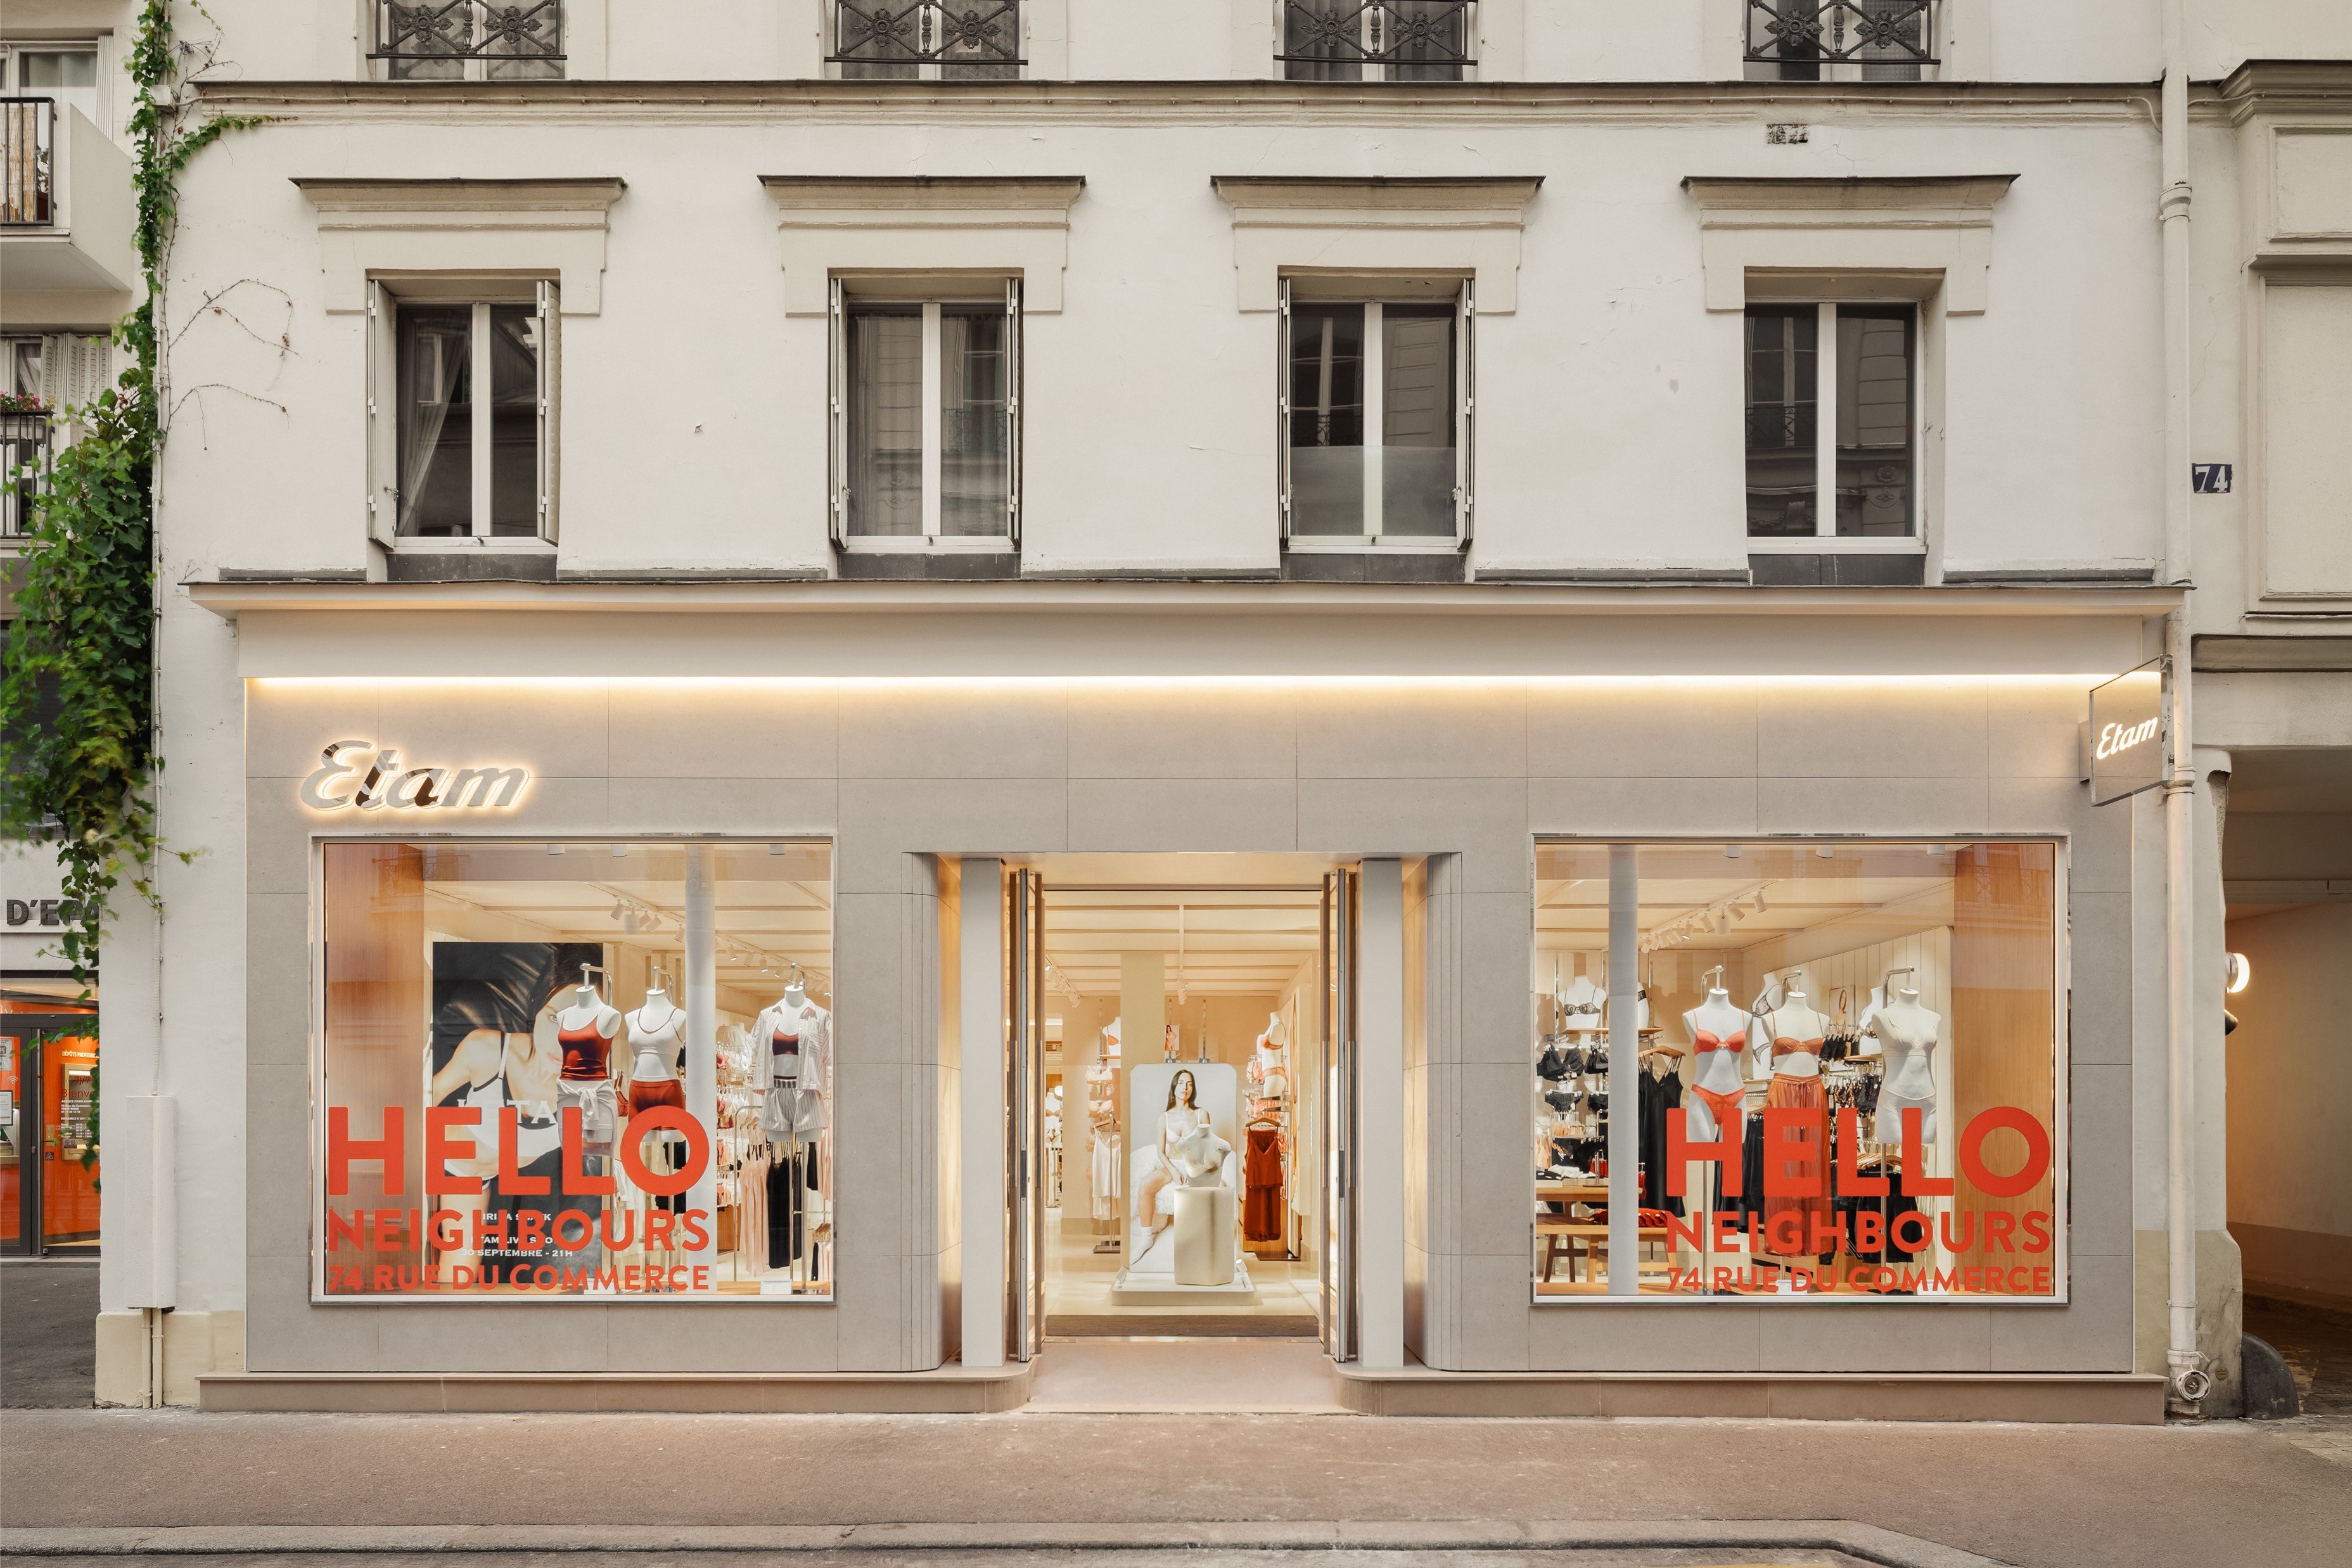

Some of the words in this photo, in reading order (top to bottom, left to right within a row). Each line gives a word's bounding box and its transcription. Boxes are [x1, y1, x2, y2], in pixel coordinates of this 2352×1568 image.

[2195, 466, 2228, 493] 74
[2095, 717, 2159, 760] Etam
[300, 740, 529, 810] Etam
[328, 1105, 710, 1197] HELLO
[1666, 1106, 2050, 1197] HELLO
[328, 1208, 710, 1252] NEIGHBOURS
[1665, 1211, 2050, 1253] NEIGHBOURS
[328, 1265, 364, 1291] 74
[374, 1265, 441, 1291] RUE
[452, 1265, 499, 1291] DU
[509, 1263, 710, 1291] COMMERCE
[1667, 1267, 1703, 1292] 74
[1713, 1266, 1779, 1292] RUE
[1790, 1266, 1838, 1292] DU
[1848, 1266, 2050, 1292] COMMERCE
